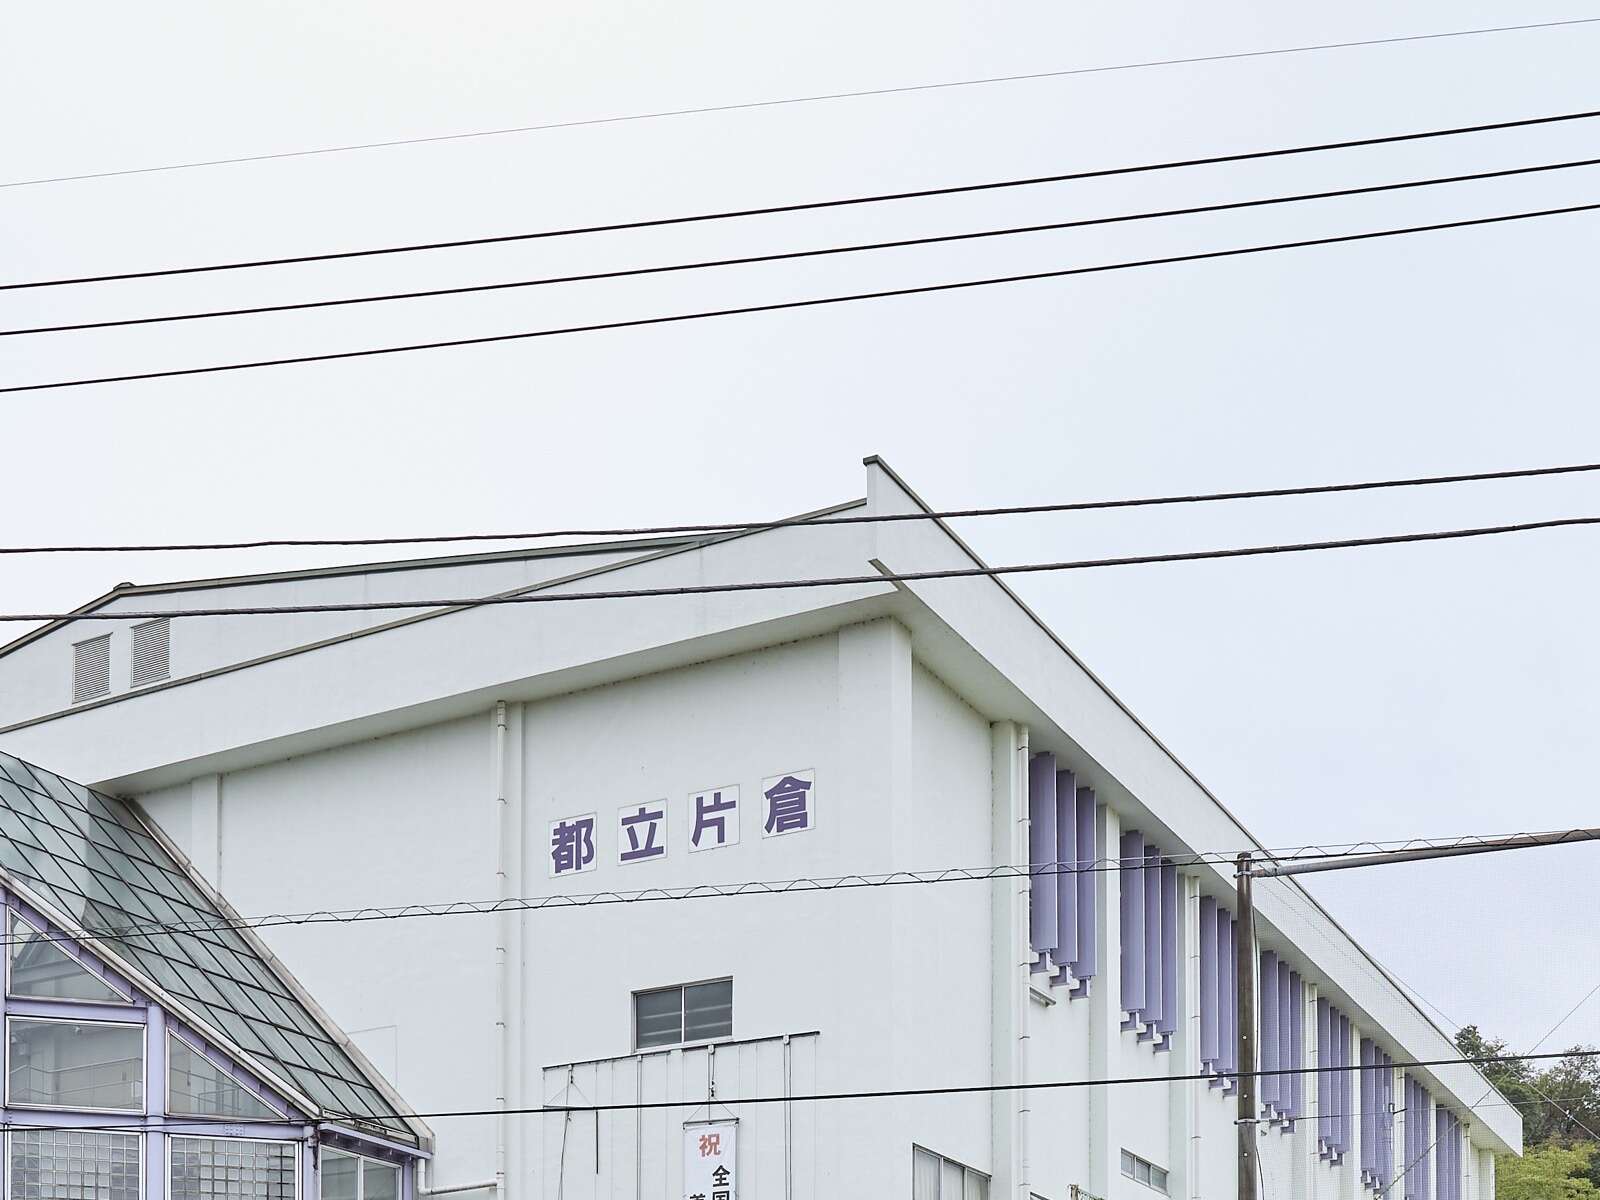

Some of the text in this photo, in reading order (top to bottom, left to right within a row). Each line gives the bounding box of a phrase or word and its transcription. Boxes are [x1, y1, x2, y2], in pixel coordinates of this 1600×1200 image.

[551, 775, 812, 873] 都立片倉
[699, 1133, 721, 1157] 祝
